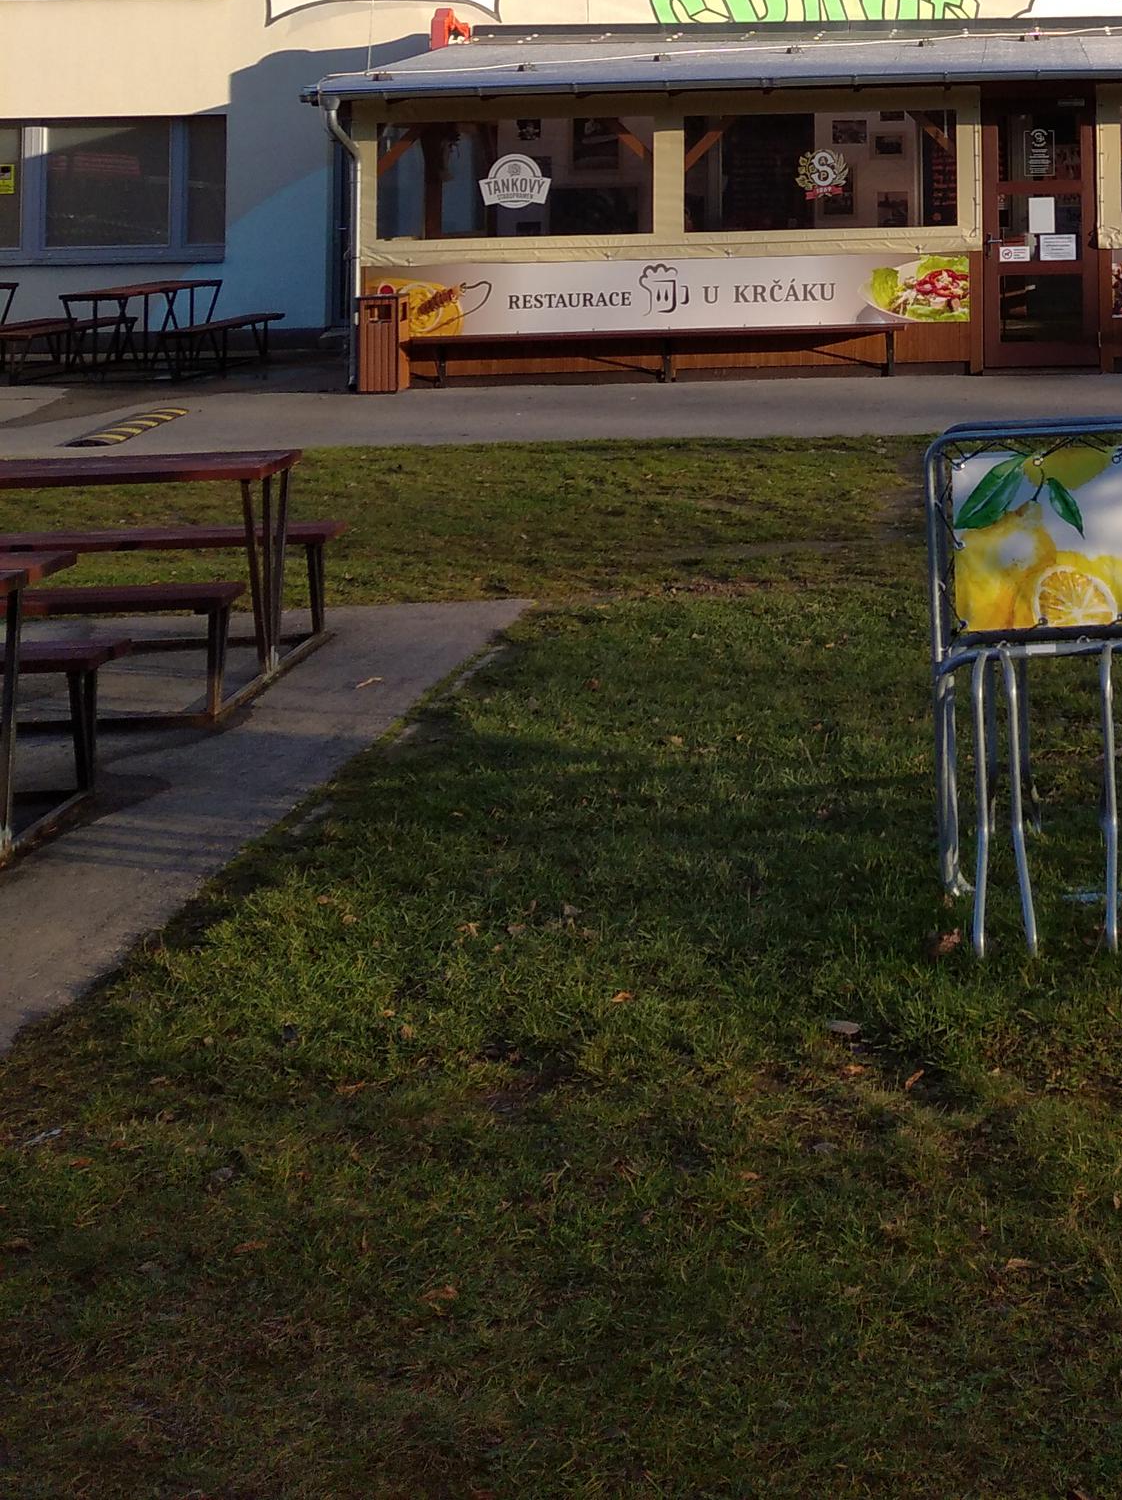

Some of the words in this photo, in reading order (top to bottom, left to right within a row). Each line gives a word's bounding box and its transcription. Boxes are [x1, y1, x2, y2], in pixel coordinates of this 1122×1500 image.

[507, 291, 633, 310] RESTAURACE
[702, 285, 721, 304] U
[733, 278, 837, 304] KRČÁKU
